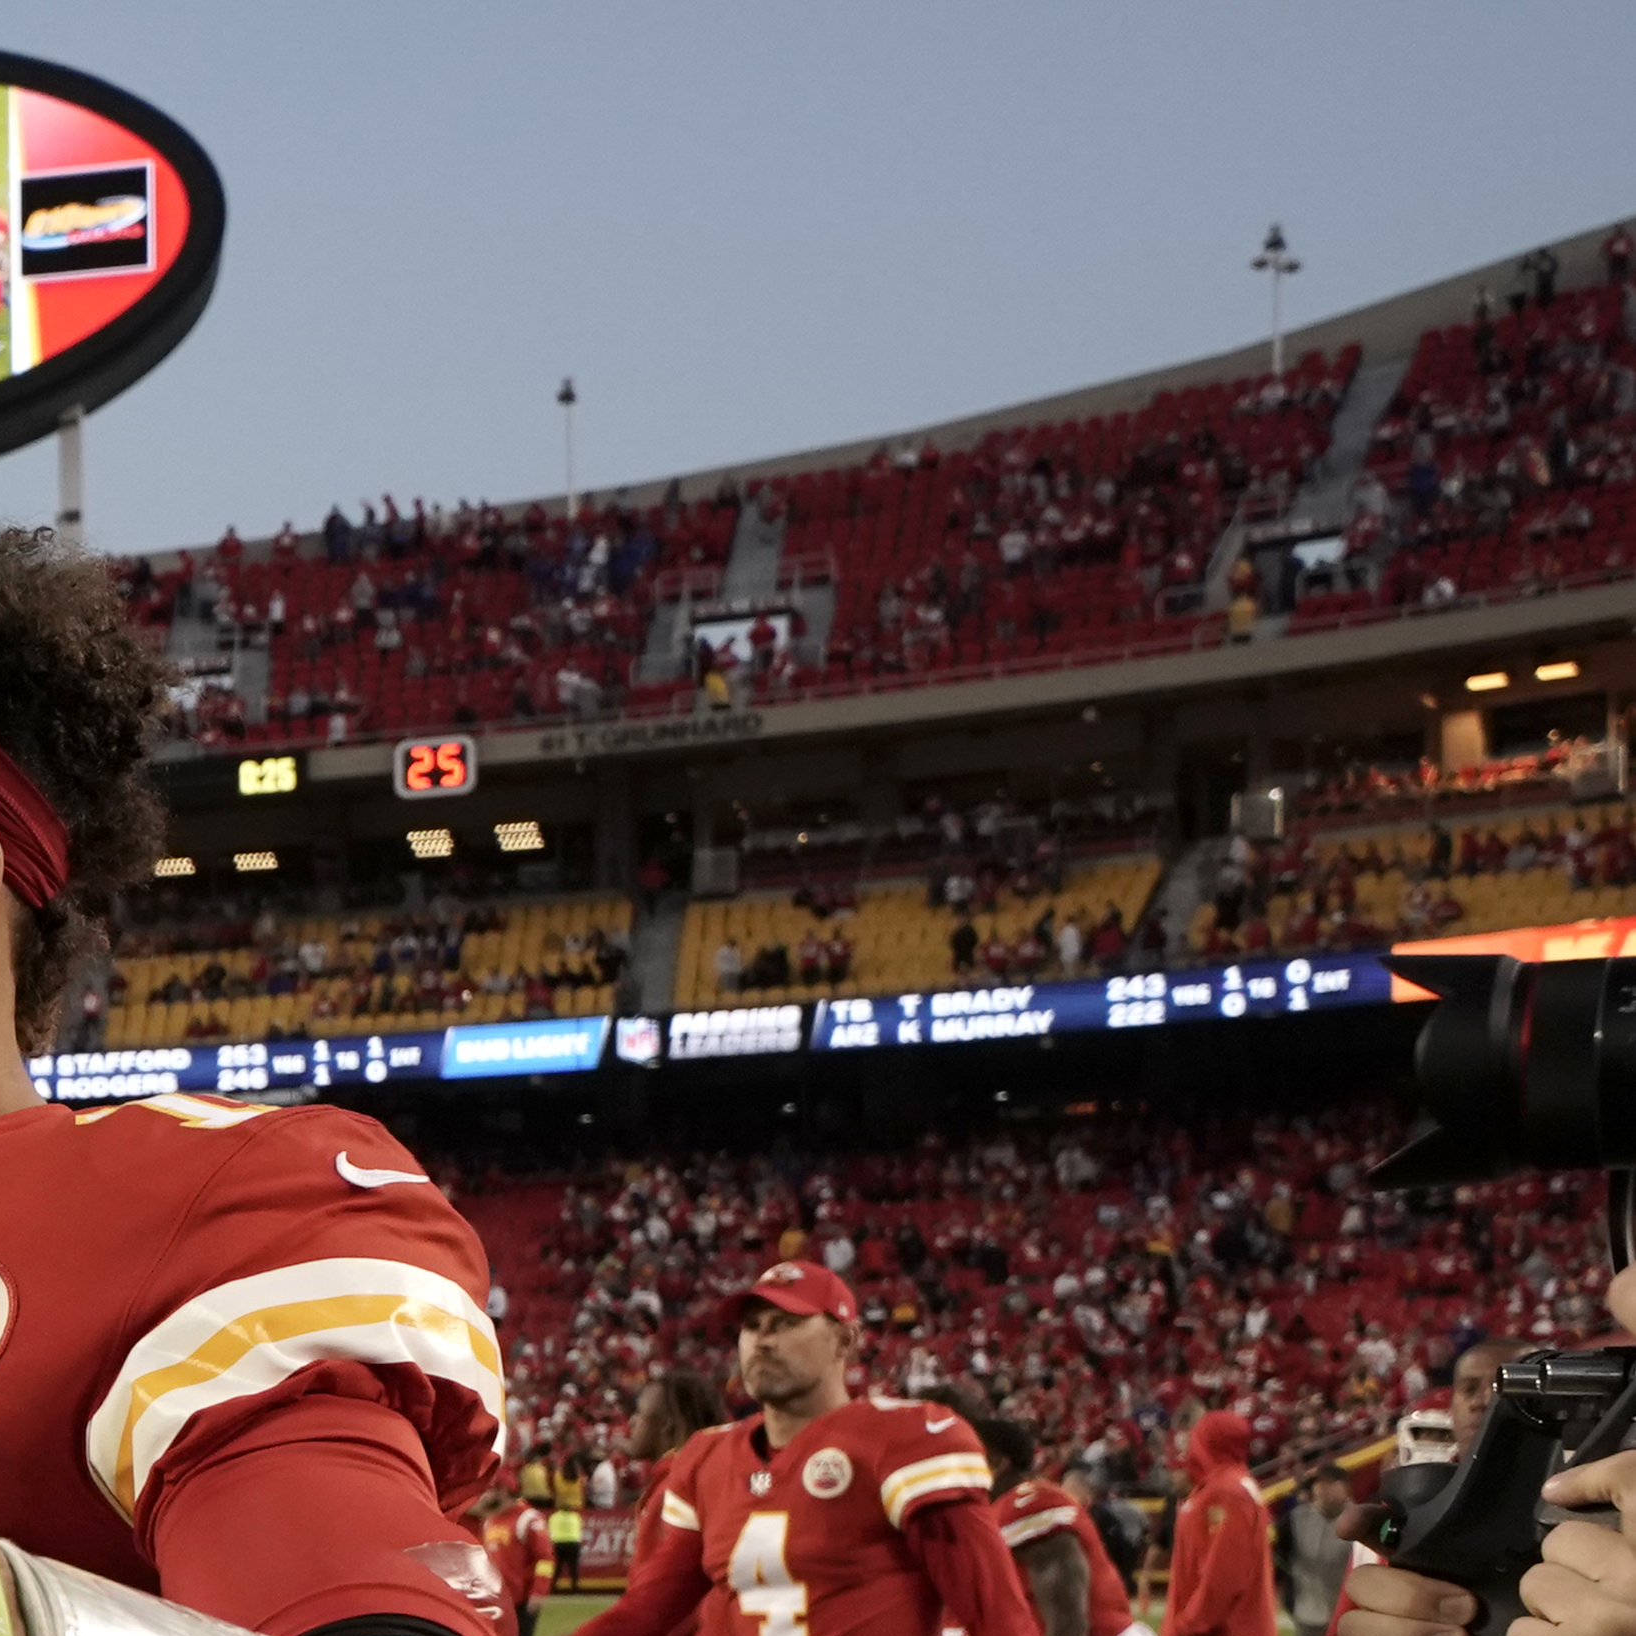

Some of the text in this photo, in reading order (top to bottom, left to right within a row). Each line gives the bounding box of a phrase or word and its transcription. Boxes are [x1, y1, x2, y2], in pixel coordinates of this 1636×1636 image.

[406, 742, 467, 791] 25
[897, 994, 923, 1018] T
[931, 985, 1035, 1017] BRADY
[1105, 972, 1167, 1001] 243
[1223, 964, 1243, 992] 1
[1285, 957, 1312, 987] 0
[897, 1019, 923, 1044] K
[931, 1009, 1055, 1043] MURRAY
[1105, 1000, 1167, 1029] 222
[1220, 991, 1248, 1018] 0
[1287, 985, 1310, 1012] 1
[56, 1048, 192, 1076] STAFFORD
[217, 1043, 268, 1068] 253
[313, 1039, 330, 1063] 1
[365, 1034, 385, 1059] 1
[455, 1031, 591, 1064] BUD LIGHT
[56, 1071, 179, 1100] RODGERS
[217, 1066, 269, 1092] 246
[313, 1062, 332, 1087] 1
[363, 1058, 389, 1084] 0
